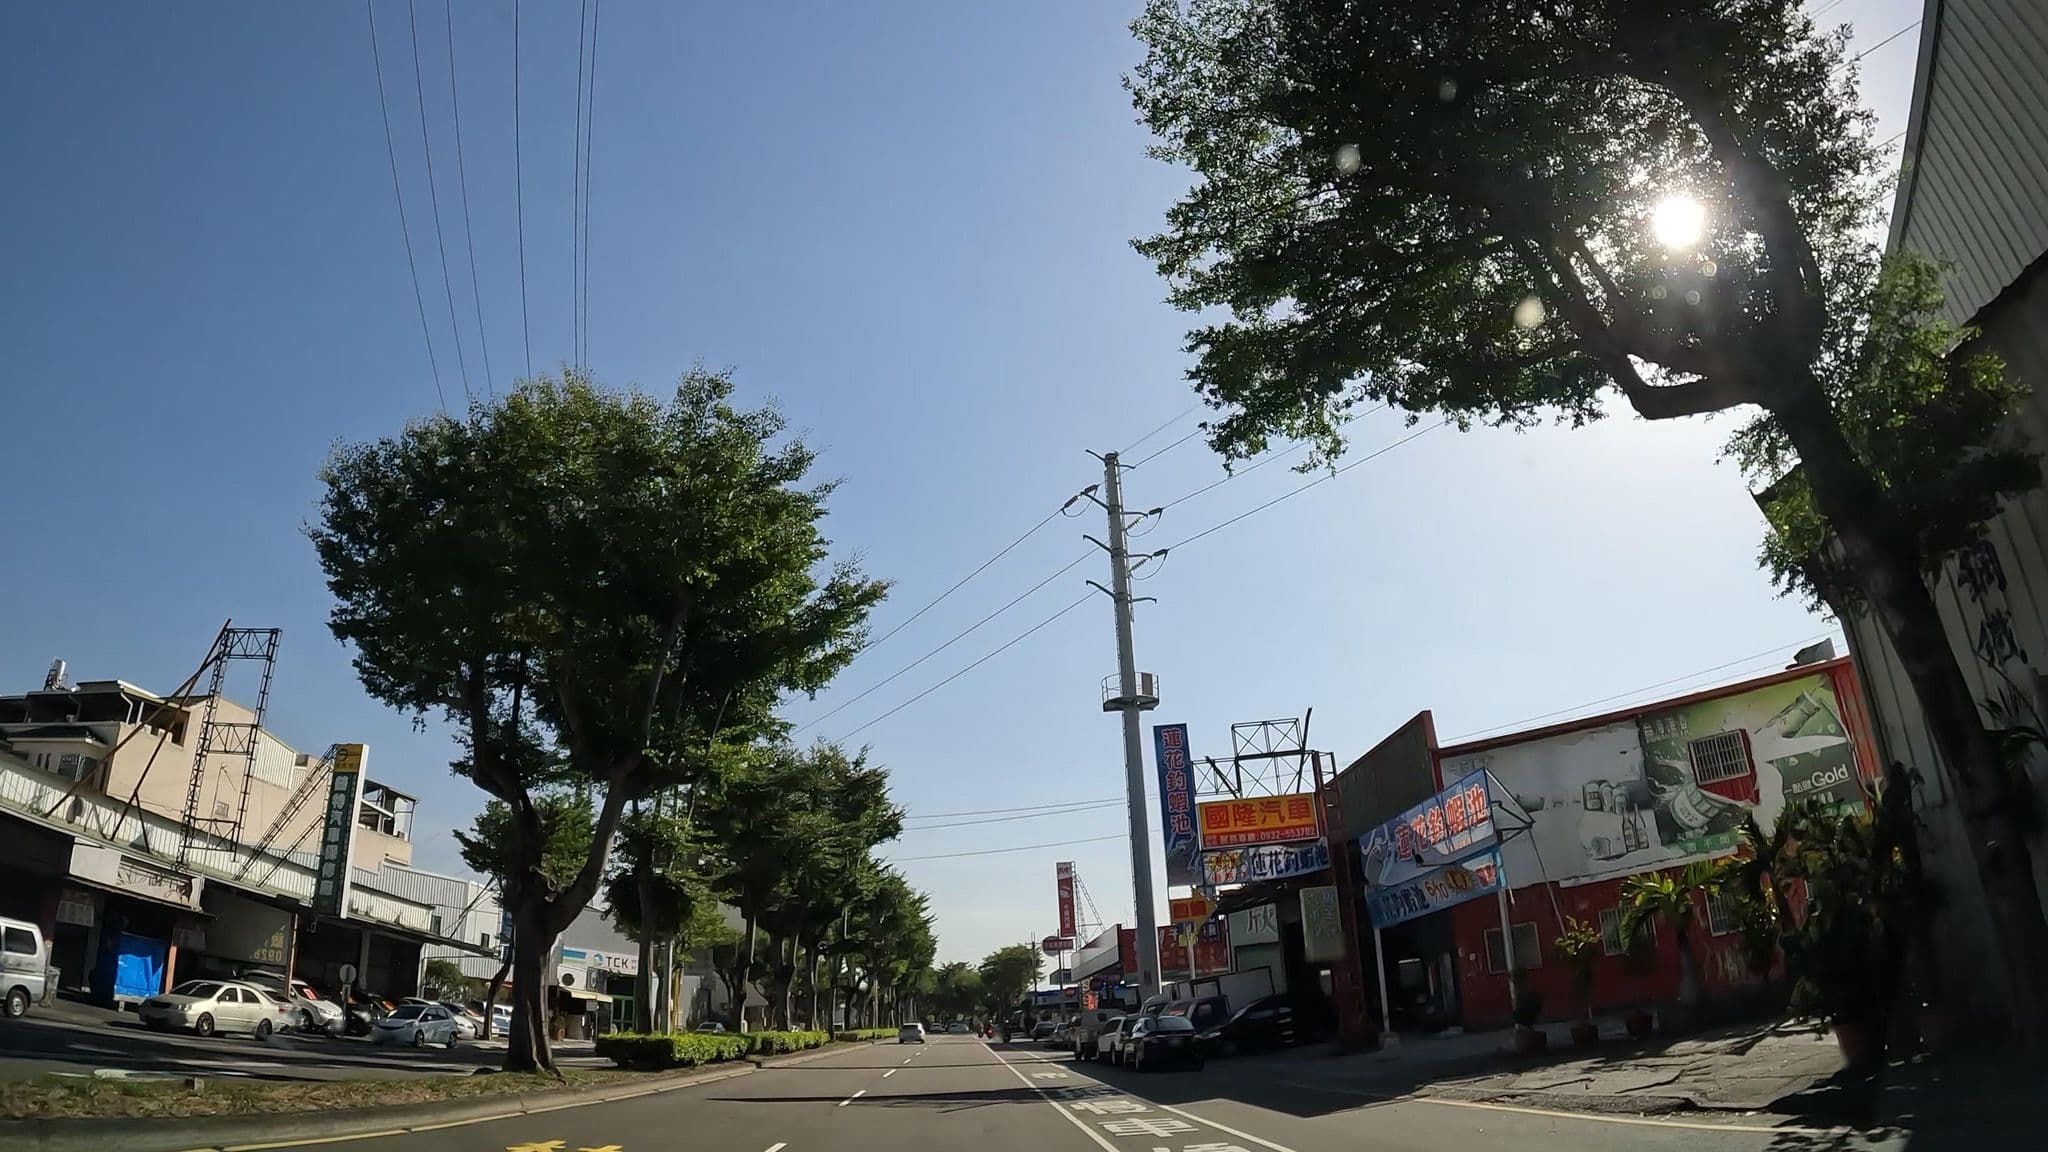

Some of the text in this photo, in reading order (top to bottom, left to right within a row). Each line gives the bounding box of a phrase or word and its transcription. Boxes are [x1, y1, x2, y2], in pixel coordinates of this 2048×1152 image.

[1161, 728, 1192, 834] 蓮花釣蝦池
[1812, 763, 1849, 787] Gold
[1205, 797, 1311, 829] 國隆汽車
[1395, 784, 1490, 861] 蓮花釣蝦池
[605, 956, 629, 969] TCK
